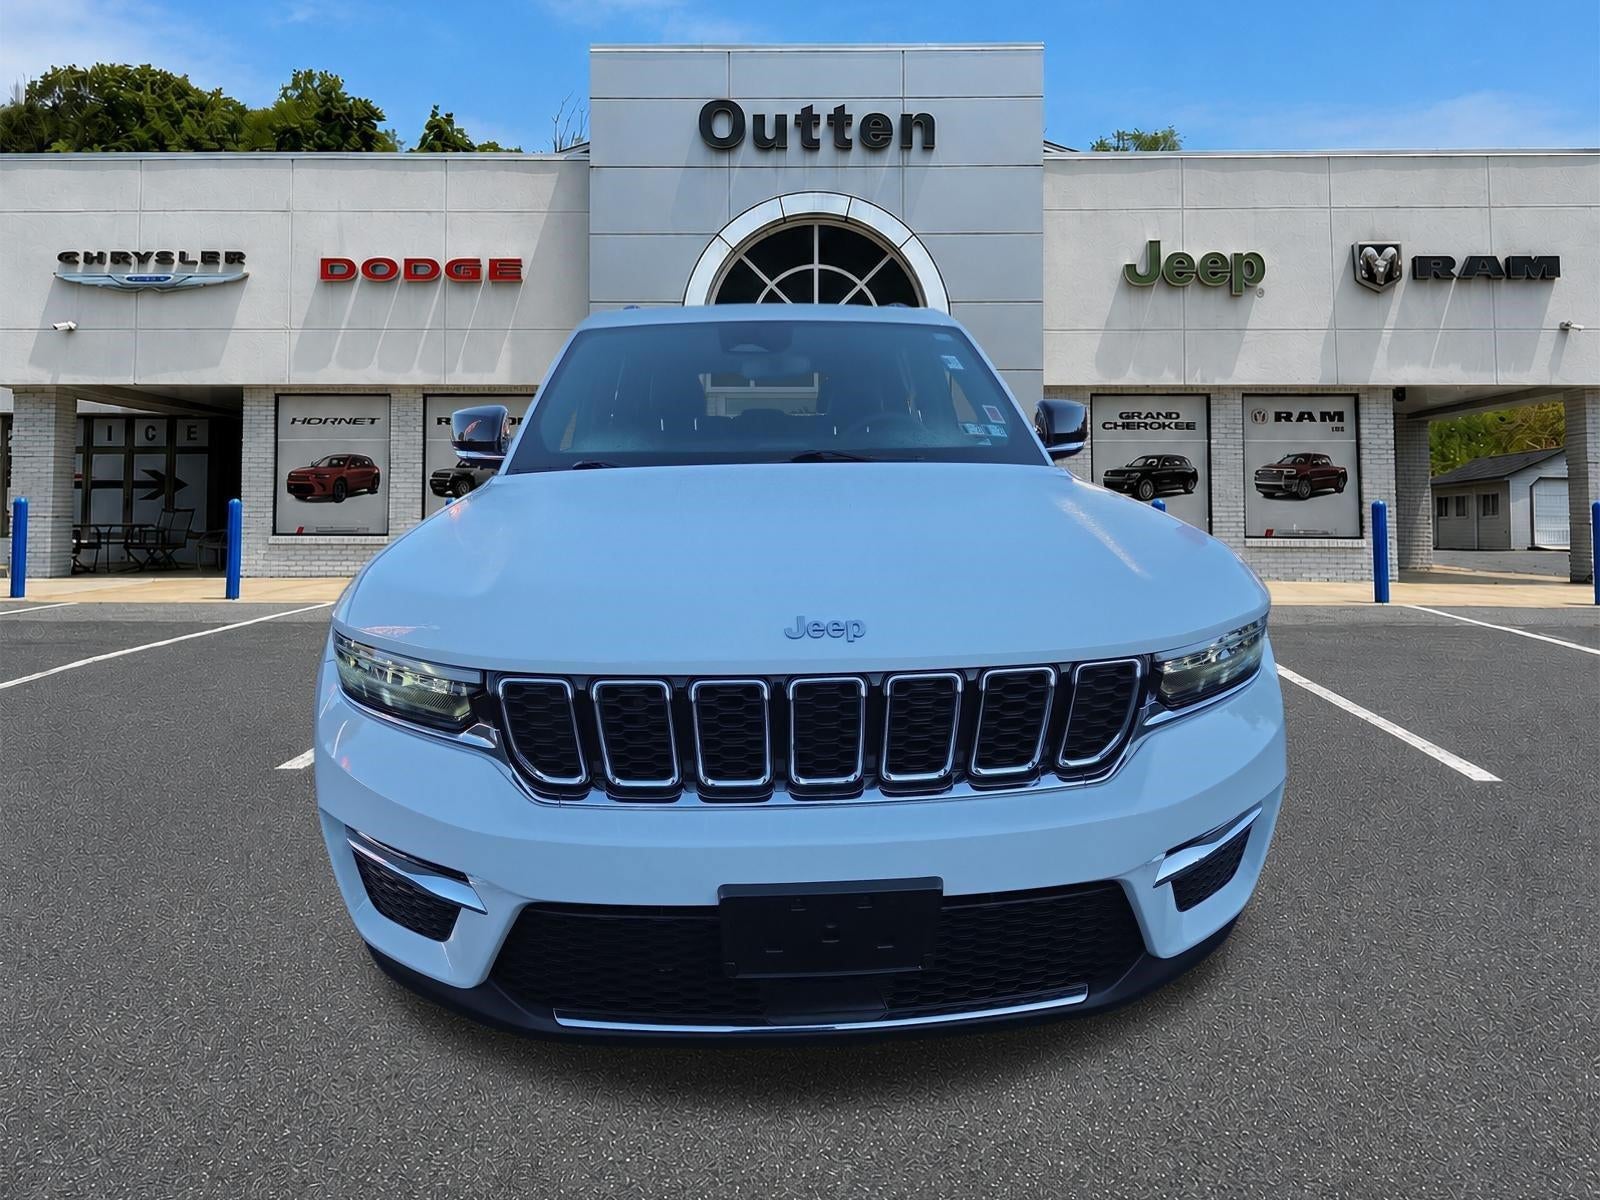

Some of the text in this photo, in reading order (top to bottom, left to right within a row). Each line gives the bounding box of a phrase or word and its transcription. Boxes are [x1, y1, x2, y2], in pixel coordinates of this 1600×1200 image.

[699, 99, 936, 150] Outten
[57, 250, 247, 266] CHRYSLER
[1411, 255, 1561, 280] RAM
[320, 257, 523, 282] DODGE
[1123, 240, 1266, 297] Jeep
[290, 417, 381, 425] HORNET
[1101, 421, 1196, 430] CHEROKEE
[1118, 411, 1181, 420] GRAND
[1274, 411, 1344, 422] RAM
[784, 616, 865, 642] Jeep
